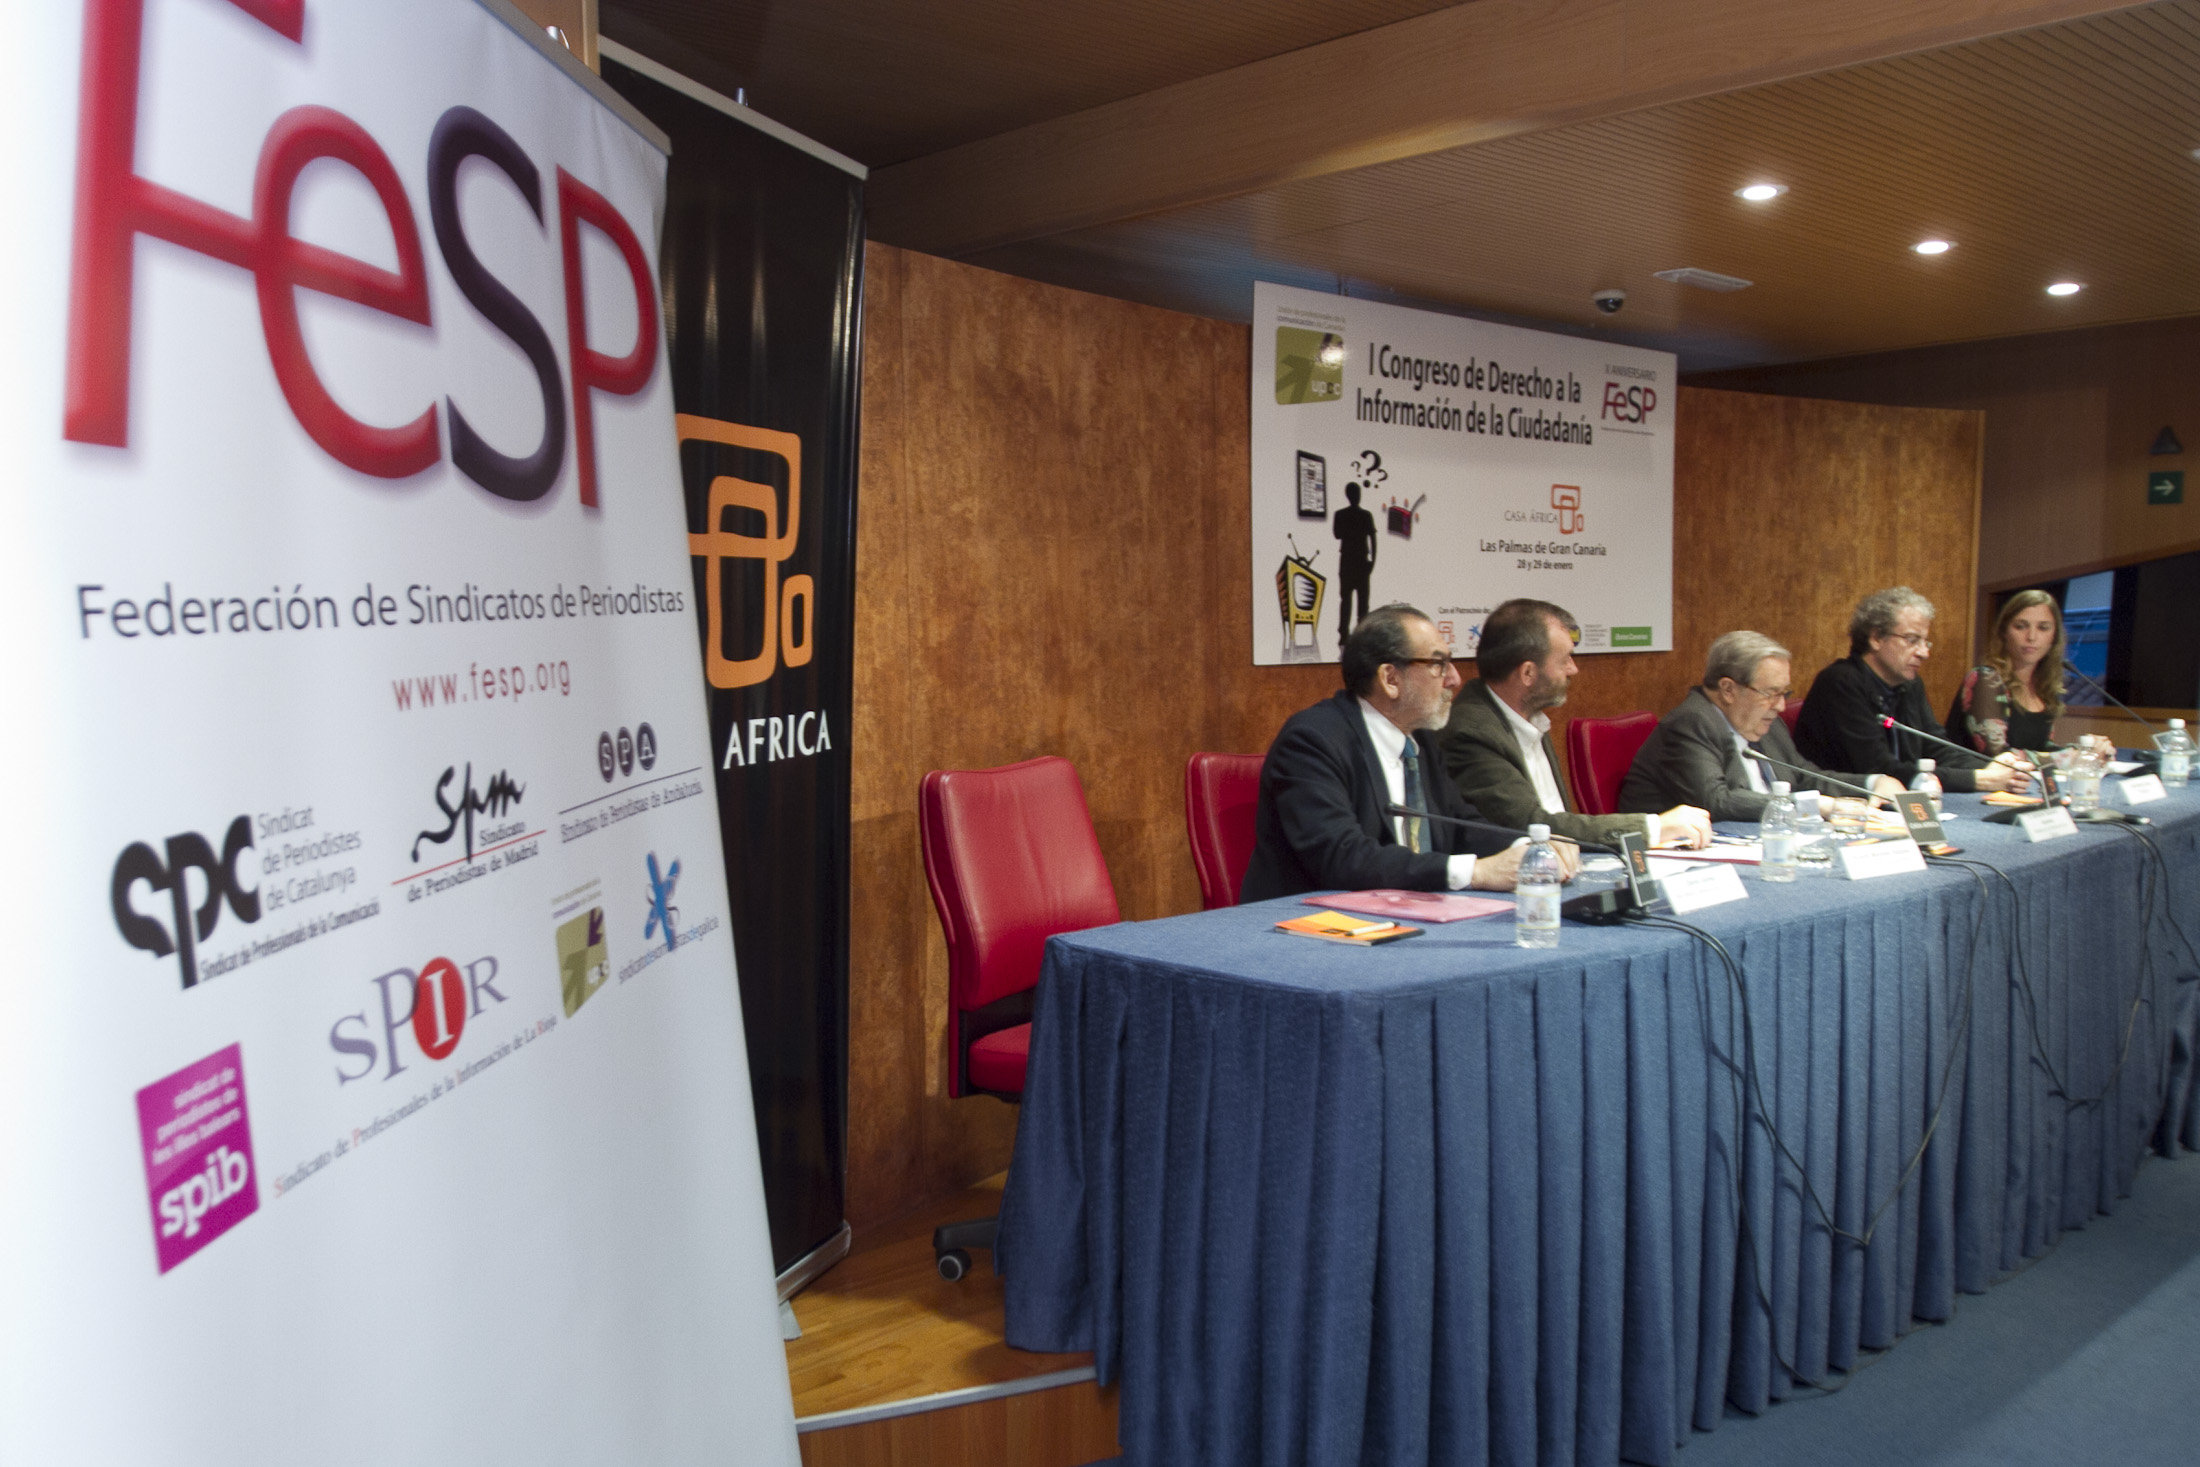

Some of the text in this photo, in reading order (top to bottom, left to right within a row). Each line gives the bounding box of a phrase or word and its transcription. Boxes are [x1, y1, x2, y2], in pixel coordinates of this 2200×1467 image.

[1368, 342, 1581, 403] I Congreso de Derecho a la
[1356, 387, 1593, 446] Información de la Ciudadanía
[1504, 509, 1526, 522] CASA
[1480, 538, 1607, 556] Las Palmas de Gran Canaria
[1543, 560, 1553, 570] de
[1553, 561, 1574, 570] enero
[76, 581, 685, 639] Federación de Sindicatos de Periodistas
[391, 660, 572, 711] www.fesp.org
[722, 708, 833, 770] AFRICA
[257, 806, 316, 840] Sindicat
[262, 830, 362, 876] de Periodistes
[265, 866, 357, 912] de Catalunya
[407, 884, 422, 903] de
[489, 854, 502, 873] de
[273, 1150, 333, 1200] Sindicato
[334, 1137, 350, 1159] de
[430, 1082, 443, 1101] de
[512, 1034, 523, 1052] de
[159, 1144, 249, 1240] spib
